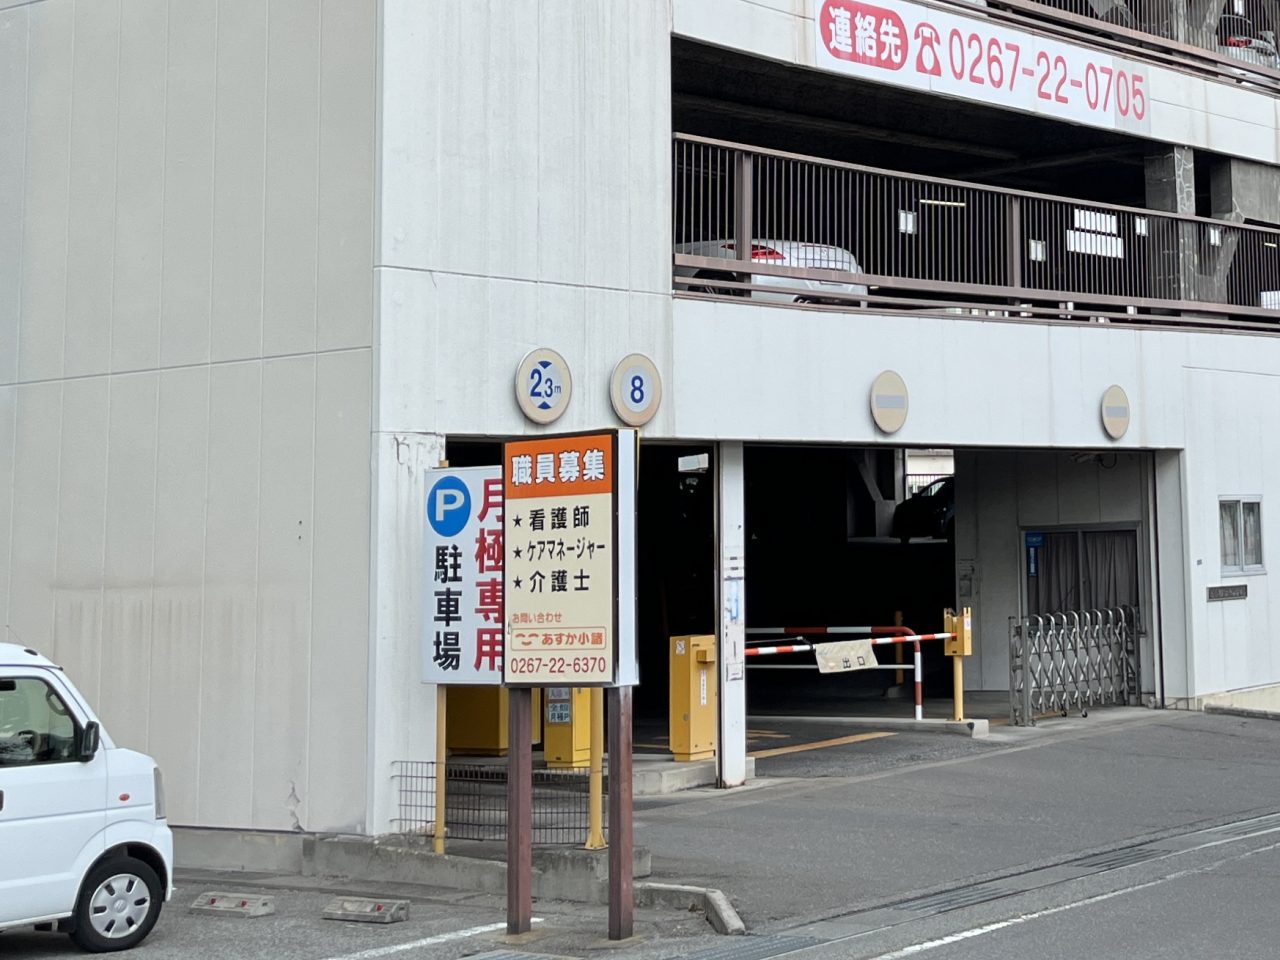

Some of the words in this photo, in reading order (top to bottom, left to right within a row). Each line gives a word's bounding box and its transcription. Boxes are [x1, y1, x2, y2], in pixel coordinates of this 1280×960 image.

[829, 6, 901, 63] 連絡先
[949, 28, 1146, 121] 0267-22-0705
[630, 375, 645, 404] 8
[511, 448, 605, 486] 職員募集
[435, 489, 465, 522] P
[529, 505, 590, 531] 看護師
[527, 537, 605, 562] ケアマネージャー
[473, 478, 503, 673] 月極専用
[529, 569, 590, 593] 介護士
[433, 544, 463, 672] 駐車場
[512, 612, 562, 624] お問い合わせ
[541, 631, 603, 646] あすか小諸
[511, 656, 606, 674] 0267-22-6370
